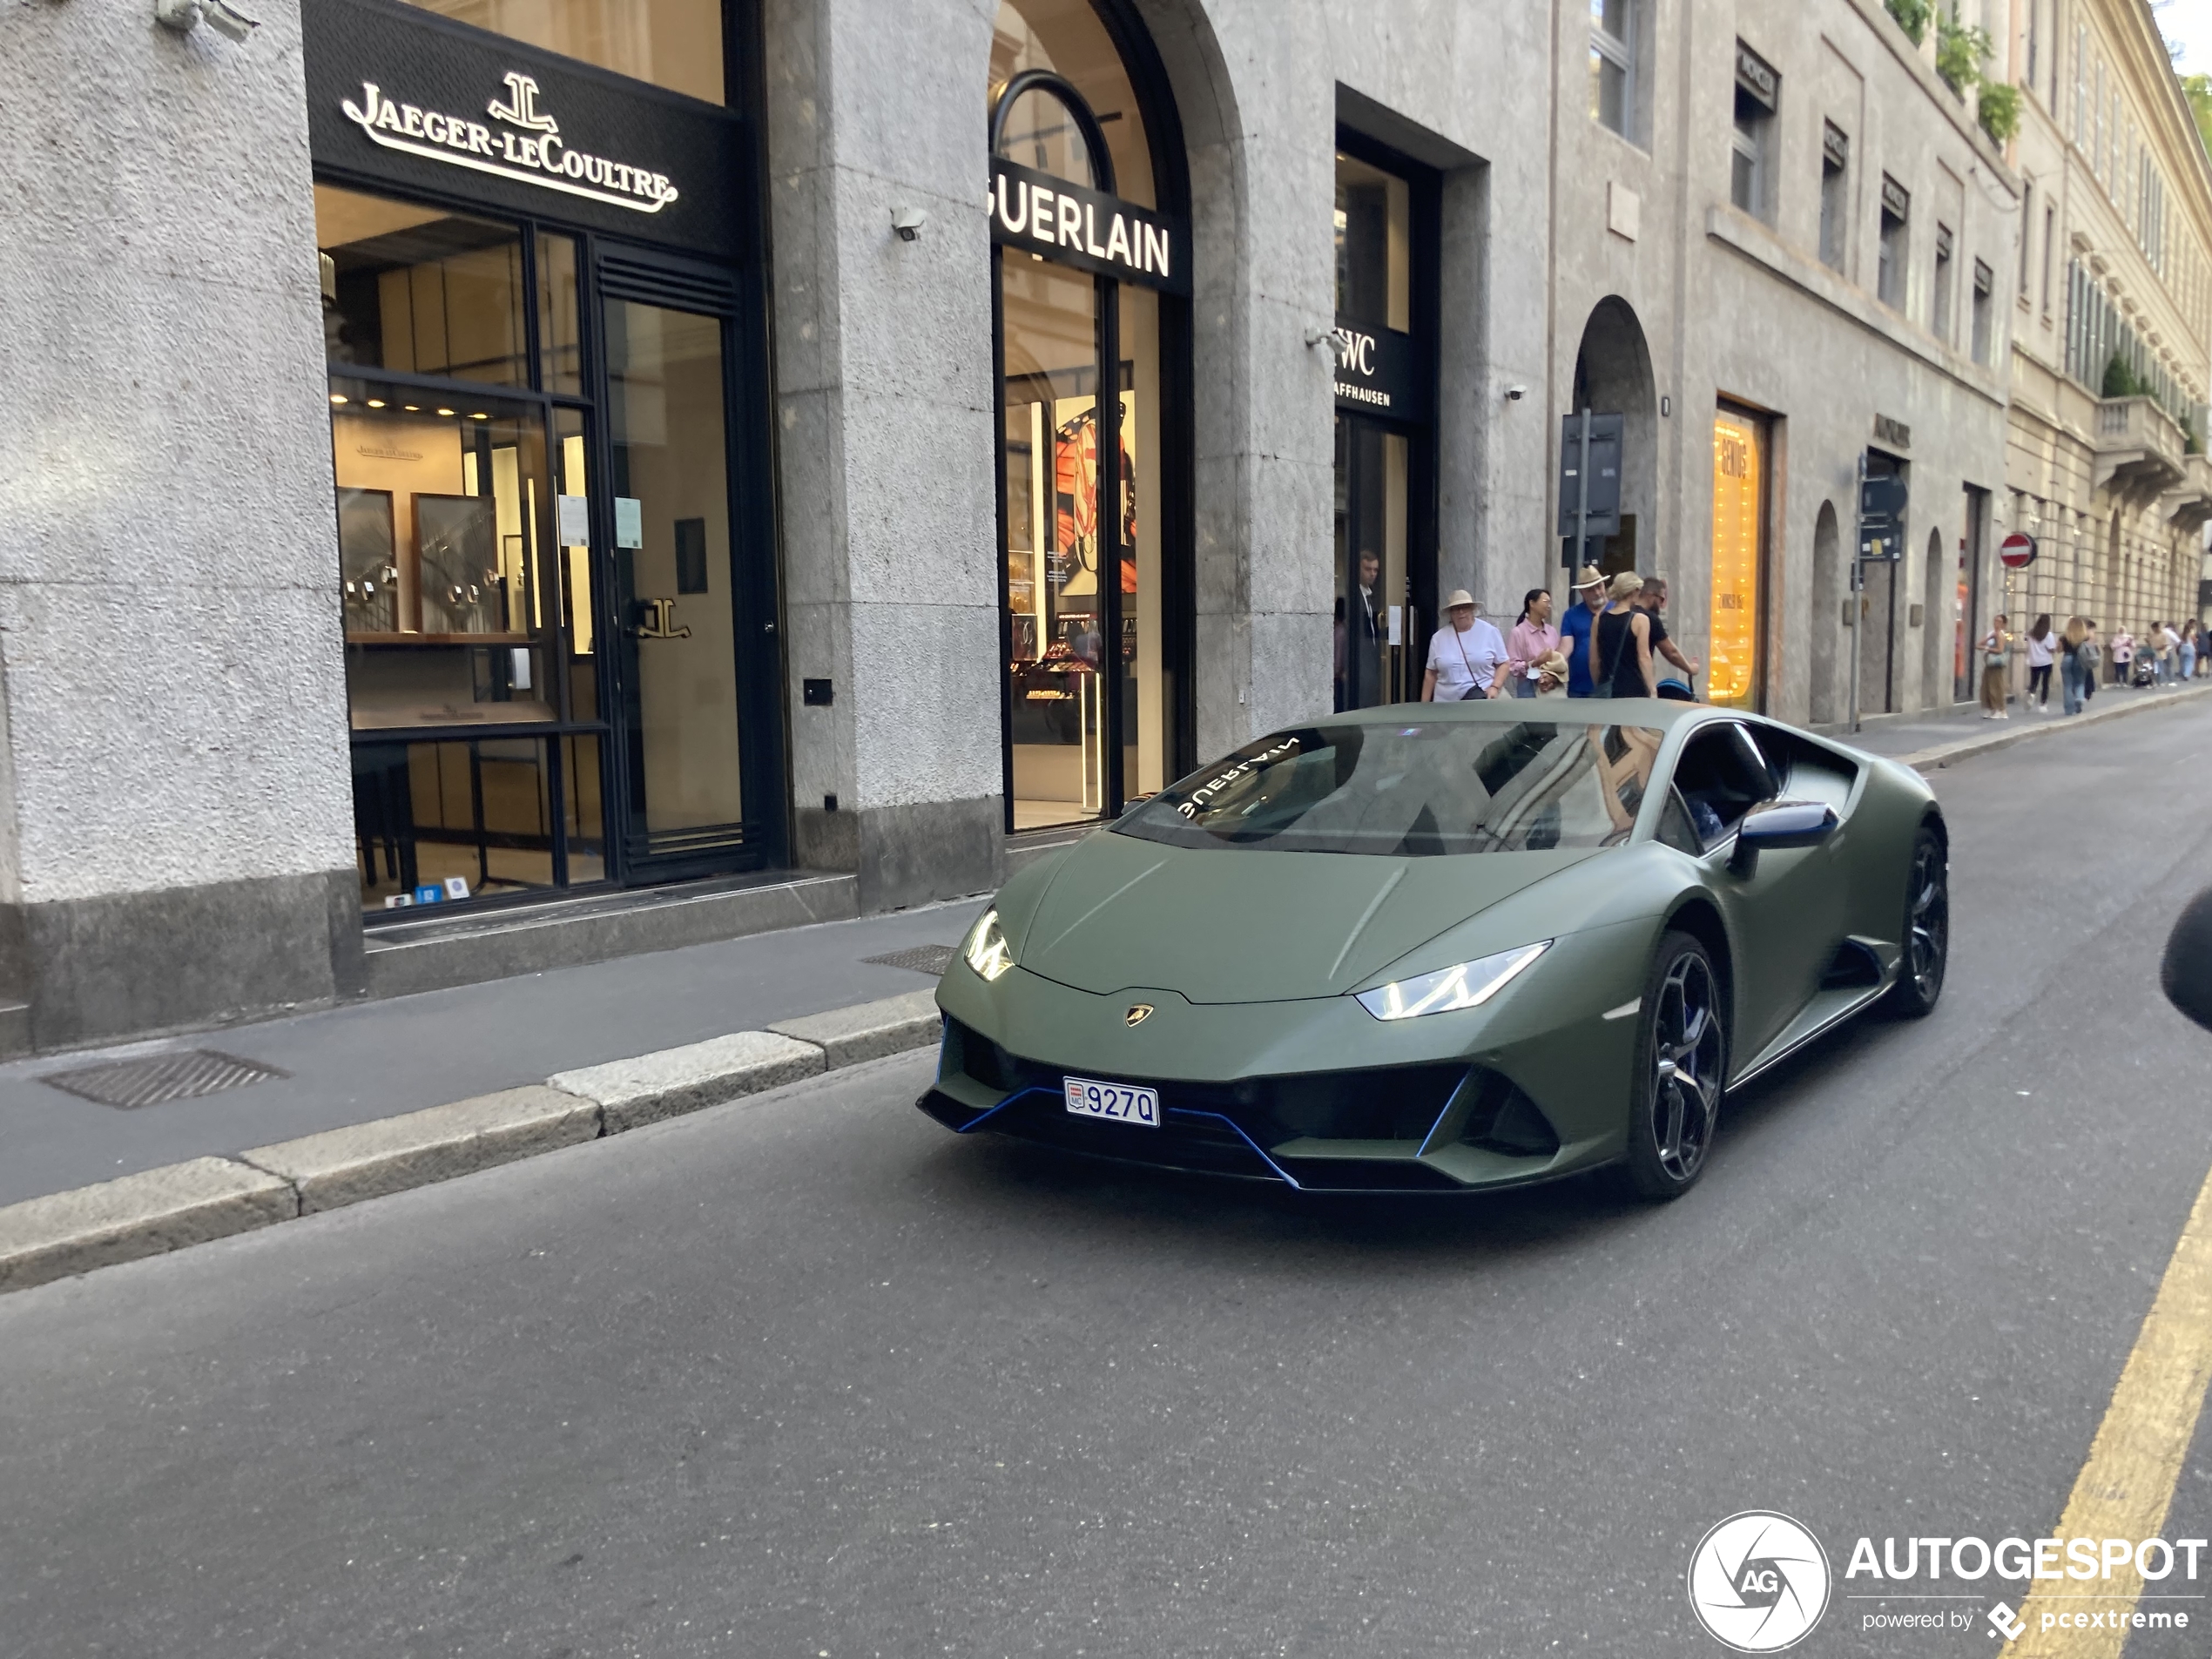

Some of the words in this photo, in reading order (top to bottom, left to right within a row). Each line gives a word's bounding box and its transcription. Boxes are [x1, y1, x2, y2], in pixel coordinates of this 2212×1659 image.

[1334, 327, 1375, 376] WC
[1071, 1096, 1082, 1106] MC
[1088, 1086, 1154, 1122] 927Q
